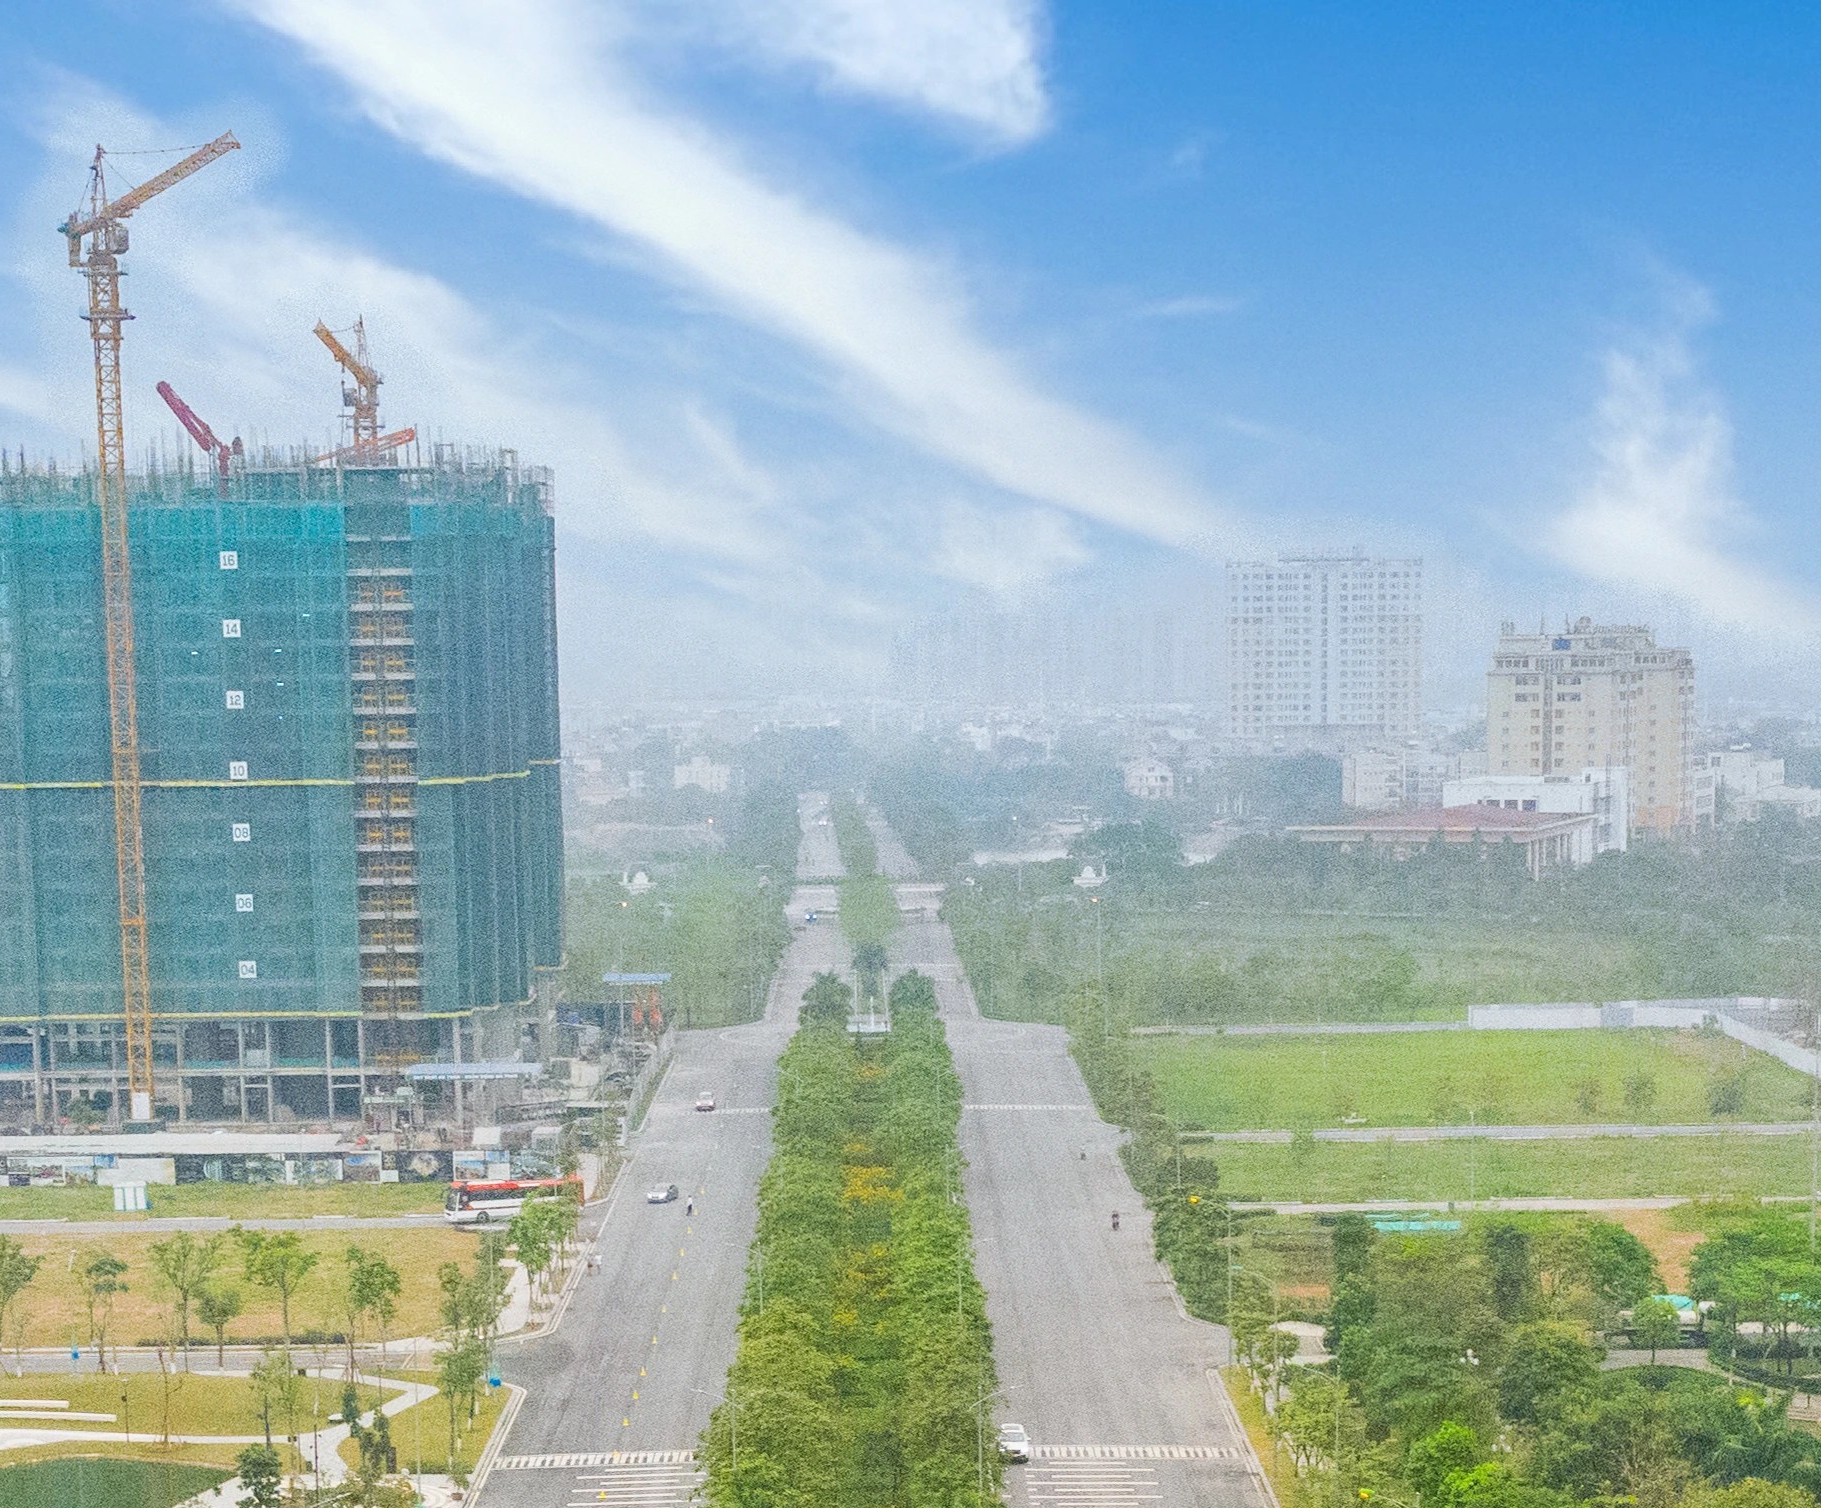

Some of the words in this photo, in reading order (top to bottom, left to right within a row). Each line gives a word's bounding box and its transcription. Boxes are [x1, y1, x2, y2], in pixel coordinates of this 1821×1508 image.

[221, 554, 236, 567] 16
[225, 623, 239, 635] 14
[229, 694, 242, 706] 12
[233, 765, 246, 777] 10
[234, 827, 249, 839] 08
[237, 898, 252, 910] 06
[240, 964, 255, 976] 04
